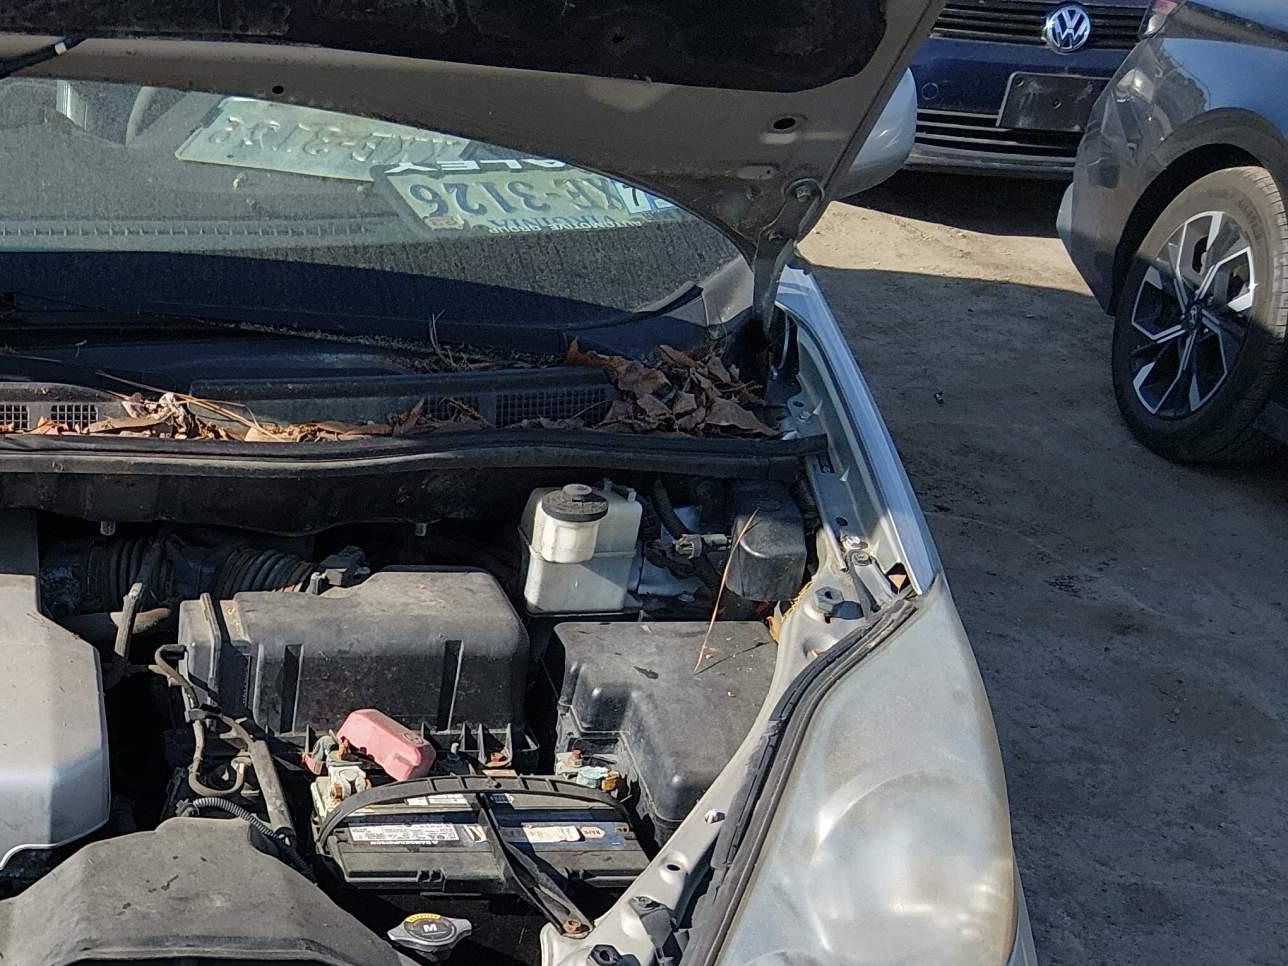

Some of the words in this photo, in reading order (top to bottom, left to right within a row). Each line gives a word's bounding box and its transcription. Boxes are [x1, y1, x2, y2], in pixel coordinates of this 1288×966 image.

[385, 158, 566, 175] ALEY
[407, 177, 624, 218] XE-3126
[547, 220, 643, 232] AUTOMOTIVE
